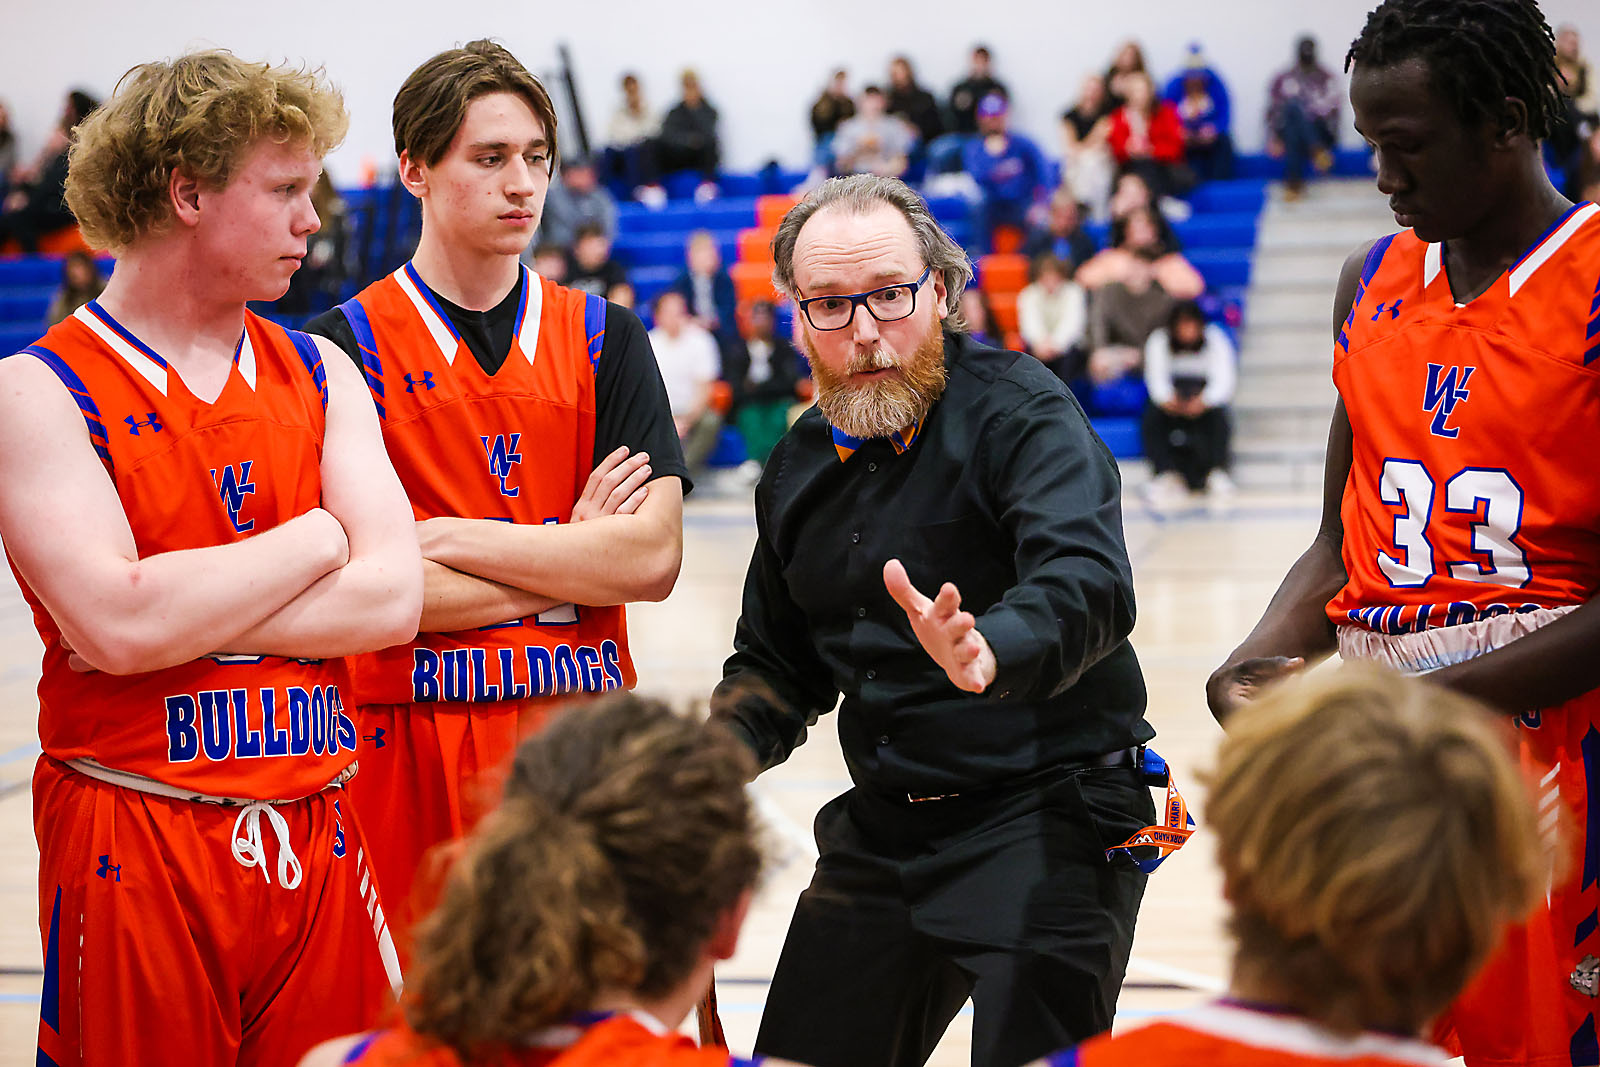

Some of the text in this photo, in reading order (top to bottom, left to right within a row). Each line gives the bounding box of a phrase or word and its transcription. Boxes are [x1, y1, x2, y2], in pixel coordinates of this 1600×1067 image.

[1377, 457, 1533, 589] 33
[412, 639, 623, 702] BULLDOGS
[165, 685, 357, 763] BULLDOGS
[1154, 832, 1170, 843] HARD
